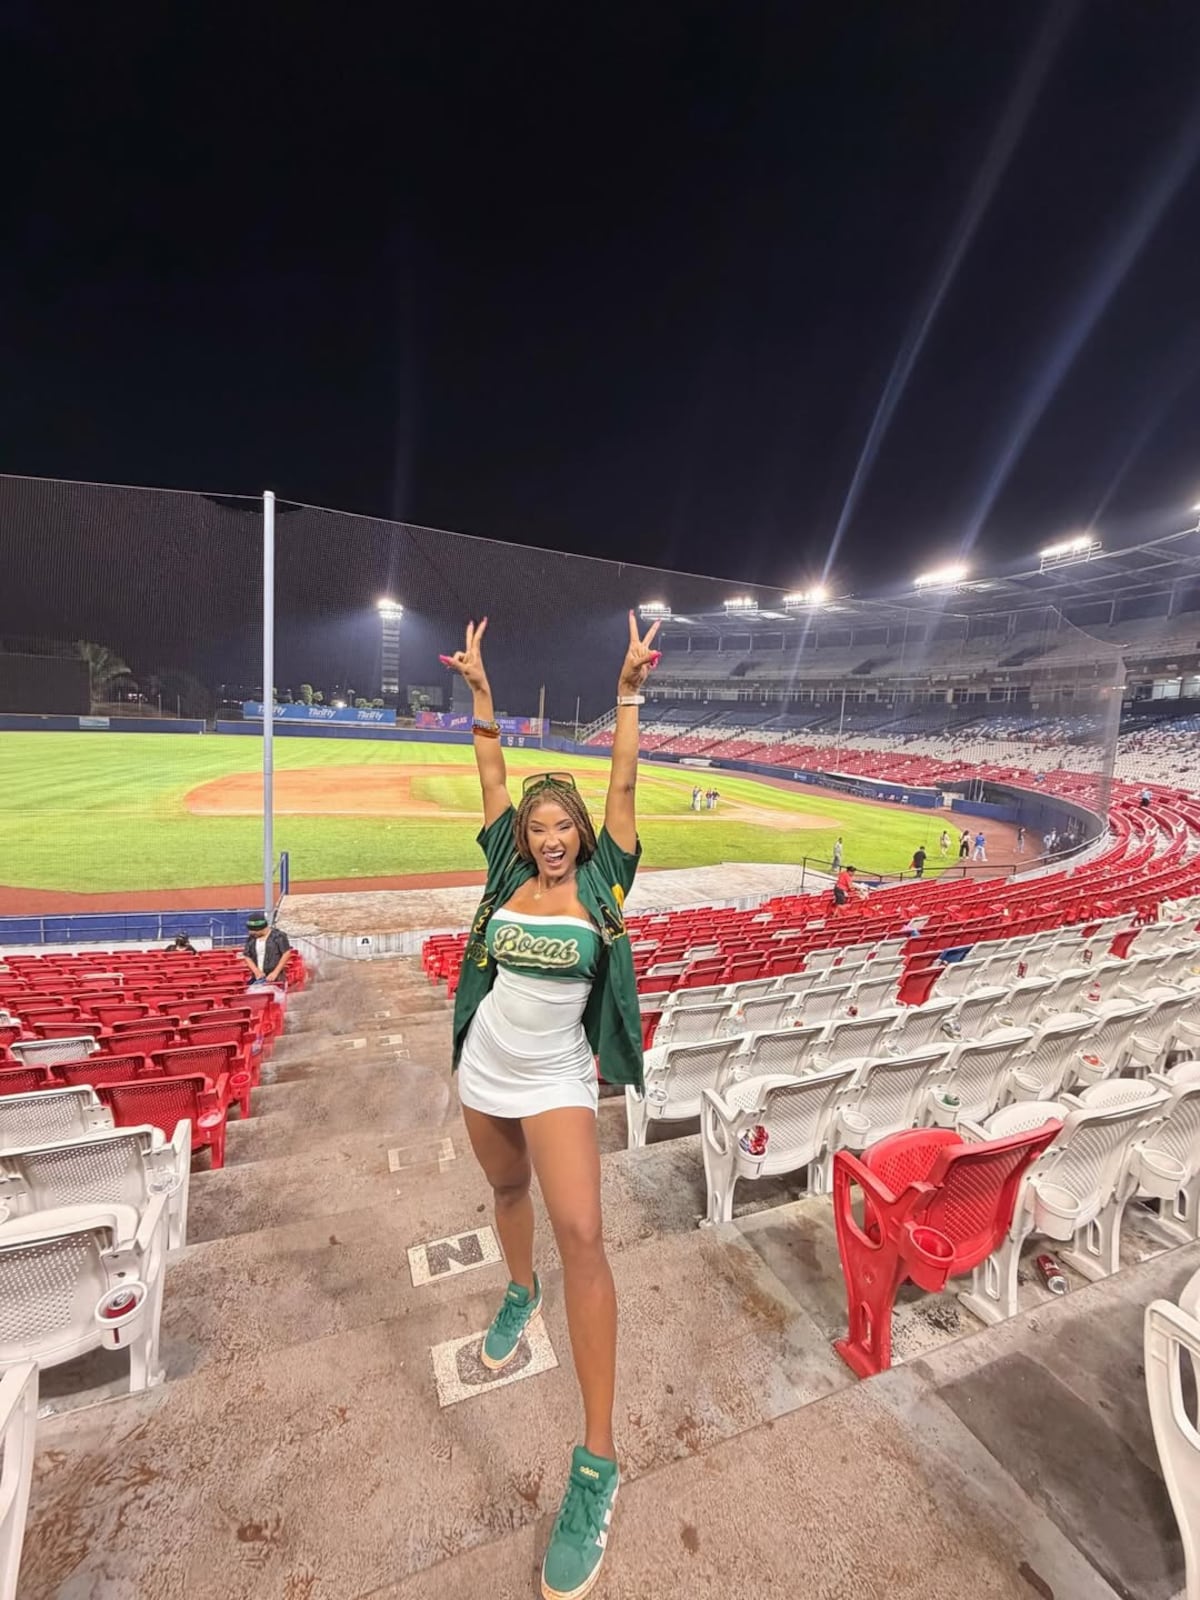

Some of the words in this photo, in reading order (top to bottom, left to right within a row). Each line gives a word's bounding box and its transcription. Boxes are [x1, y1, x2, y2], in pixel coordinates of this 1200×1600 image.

[308, 707, 336, 719] Thrifty
[357, 710, 383, 720] Thrifty
[494, 924, 578, 960] Bocas
[425, 1233, 484, 1276] N
